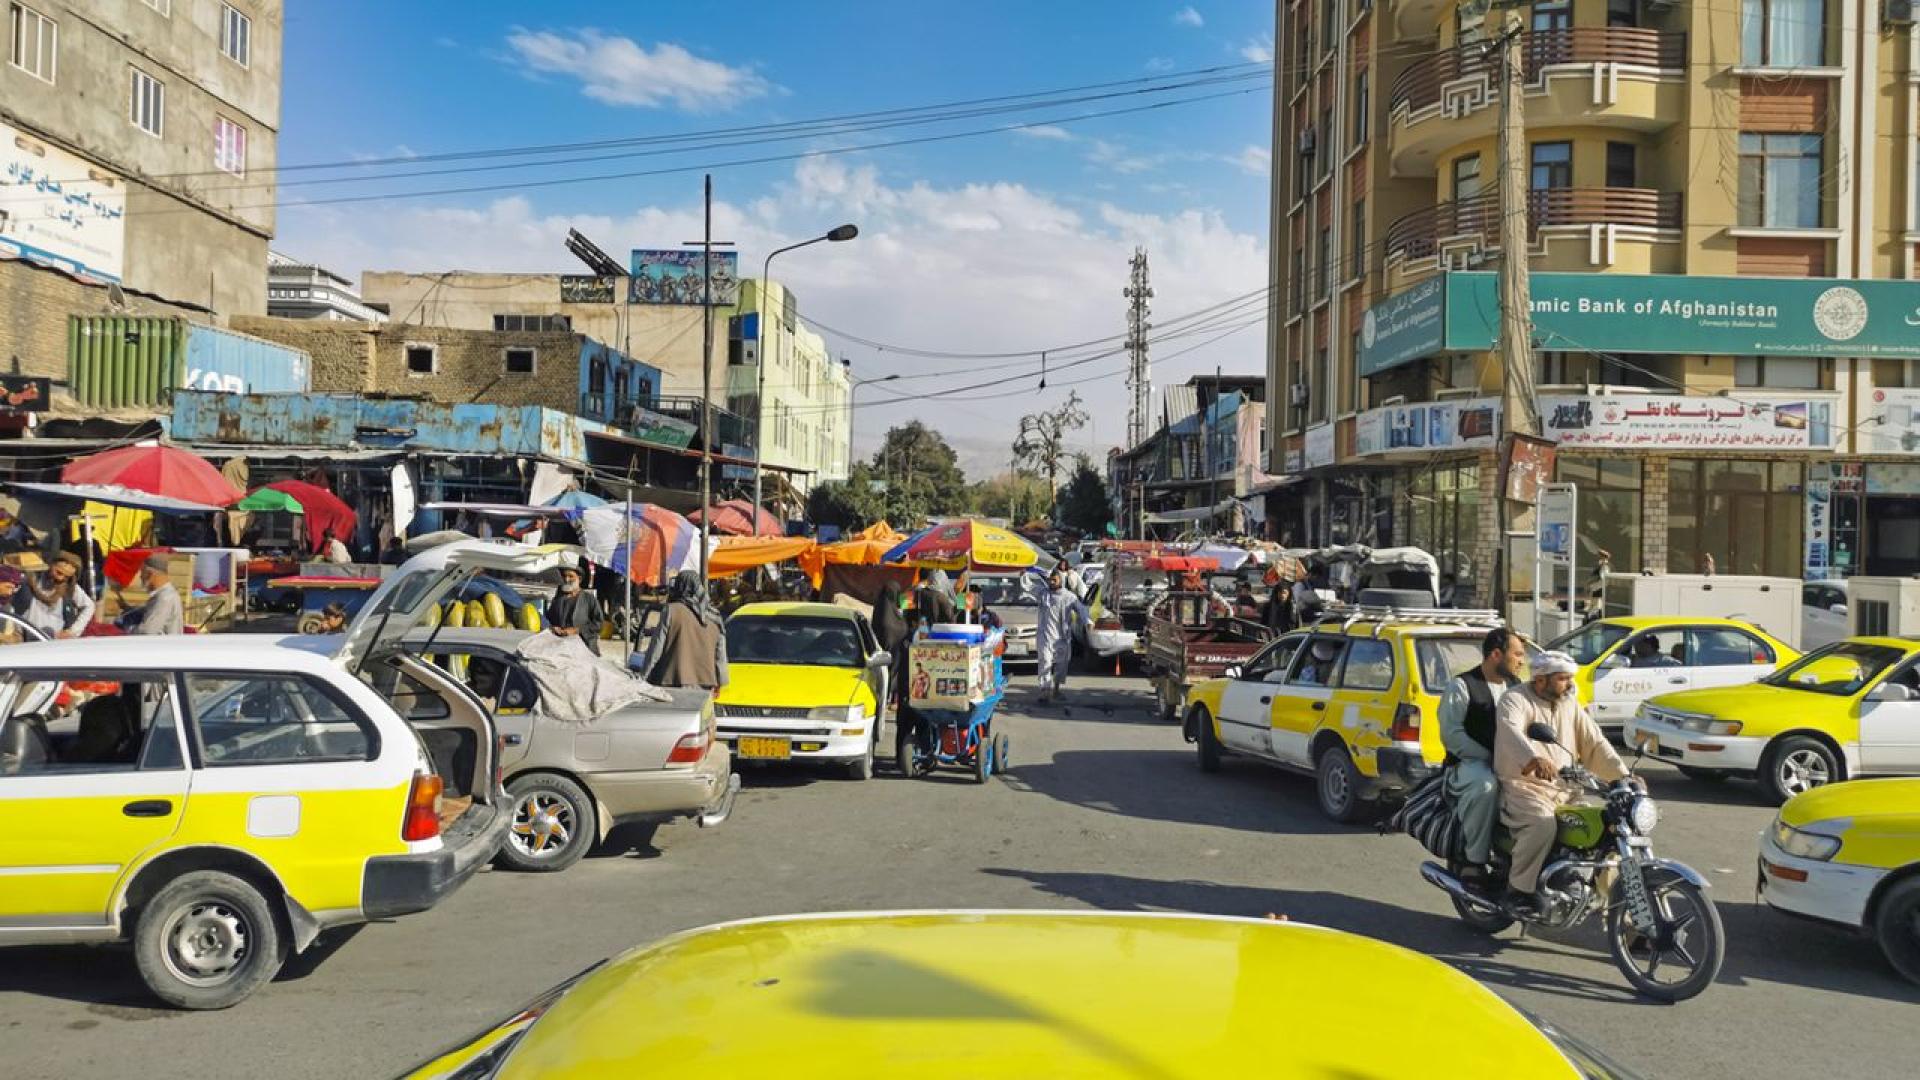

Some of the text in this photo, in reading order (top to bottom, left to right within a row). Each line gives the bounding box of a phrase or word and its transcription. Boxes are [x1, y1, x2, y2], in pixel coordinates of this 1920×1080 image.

[1528, 297, 1778, 319] amic Bank of Afghanistan
